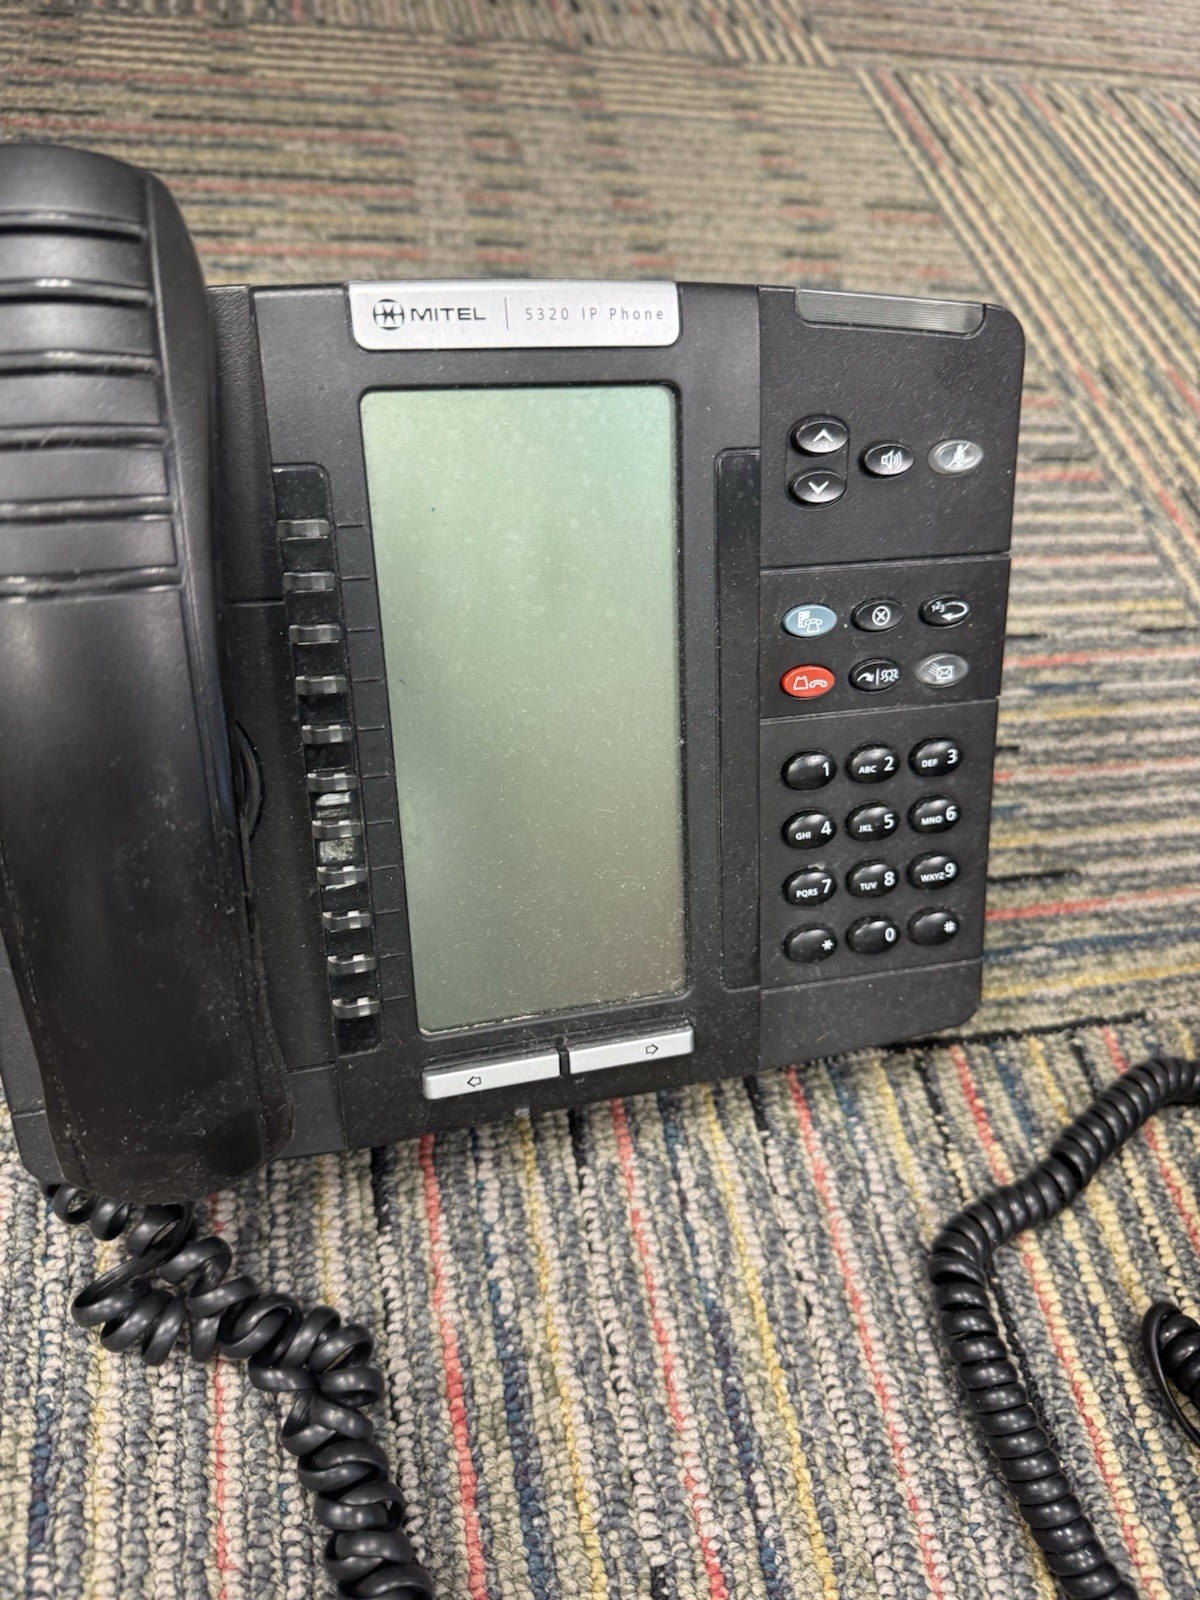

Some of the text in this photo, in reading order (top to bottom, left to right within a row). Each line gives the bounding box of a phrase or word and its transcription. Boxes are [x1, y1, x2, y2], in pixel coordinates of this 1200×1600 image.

[410, 307, 487, 322] MITEL
[525, 307, 664, 321] 5320 IP Phone
[858, 755, 895, 774] ABC 2
[921, 748, 959, 768] DEF 3
[821, 761, 830, 777] 1
[858, 813, 895, 833] JKL 5
[921, 805, 958, 826] MNO 6
[795, 820, 832, 841] GHI 4
[859, 871, 896, 891] TUV 8
[920, 862, 957, 883] WXYZ 9
[796, 878, 833, 898] PQRS 7
[884, 926, 896, 943] 0
